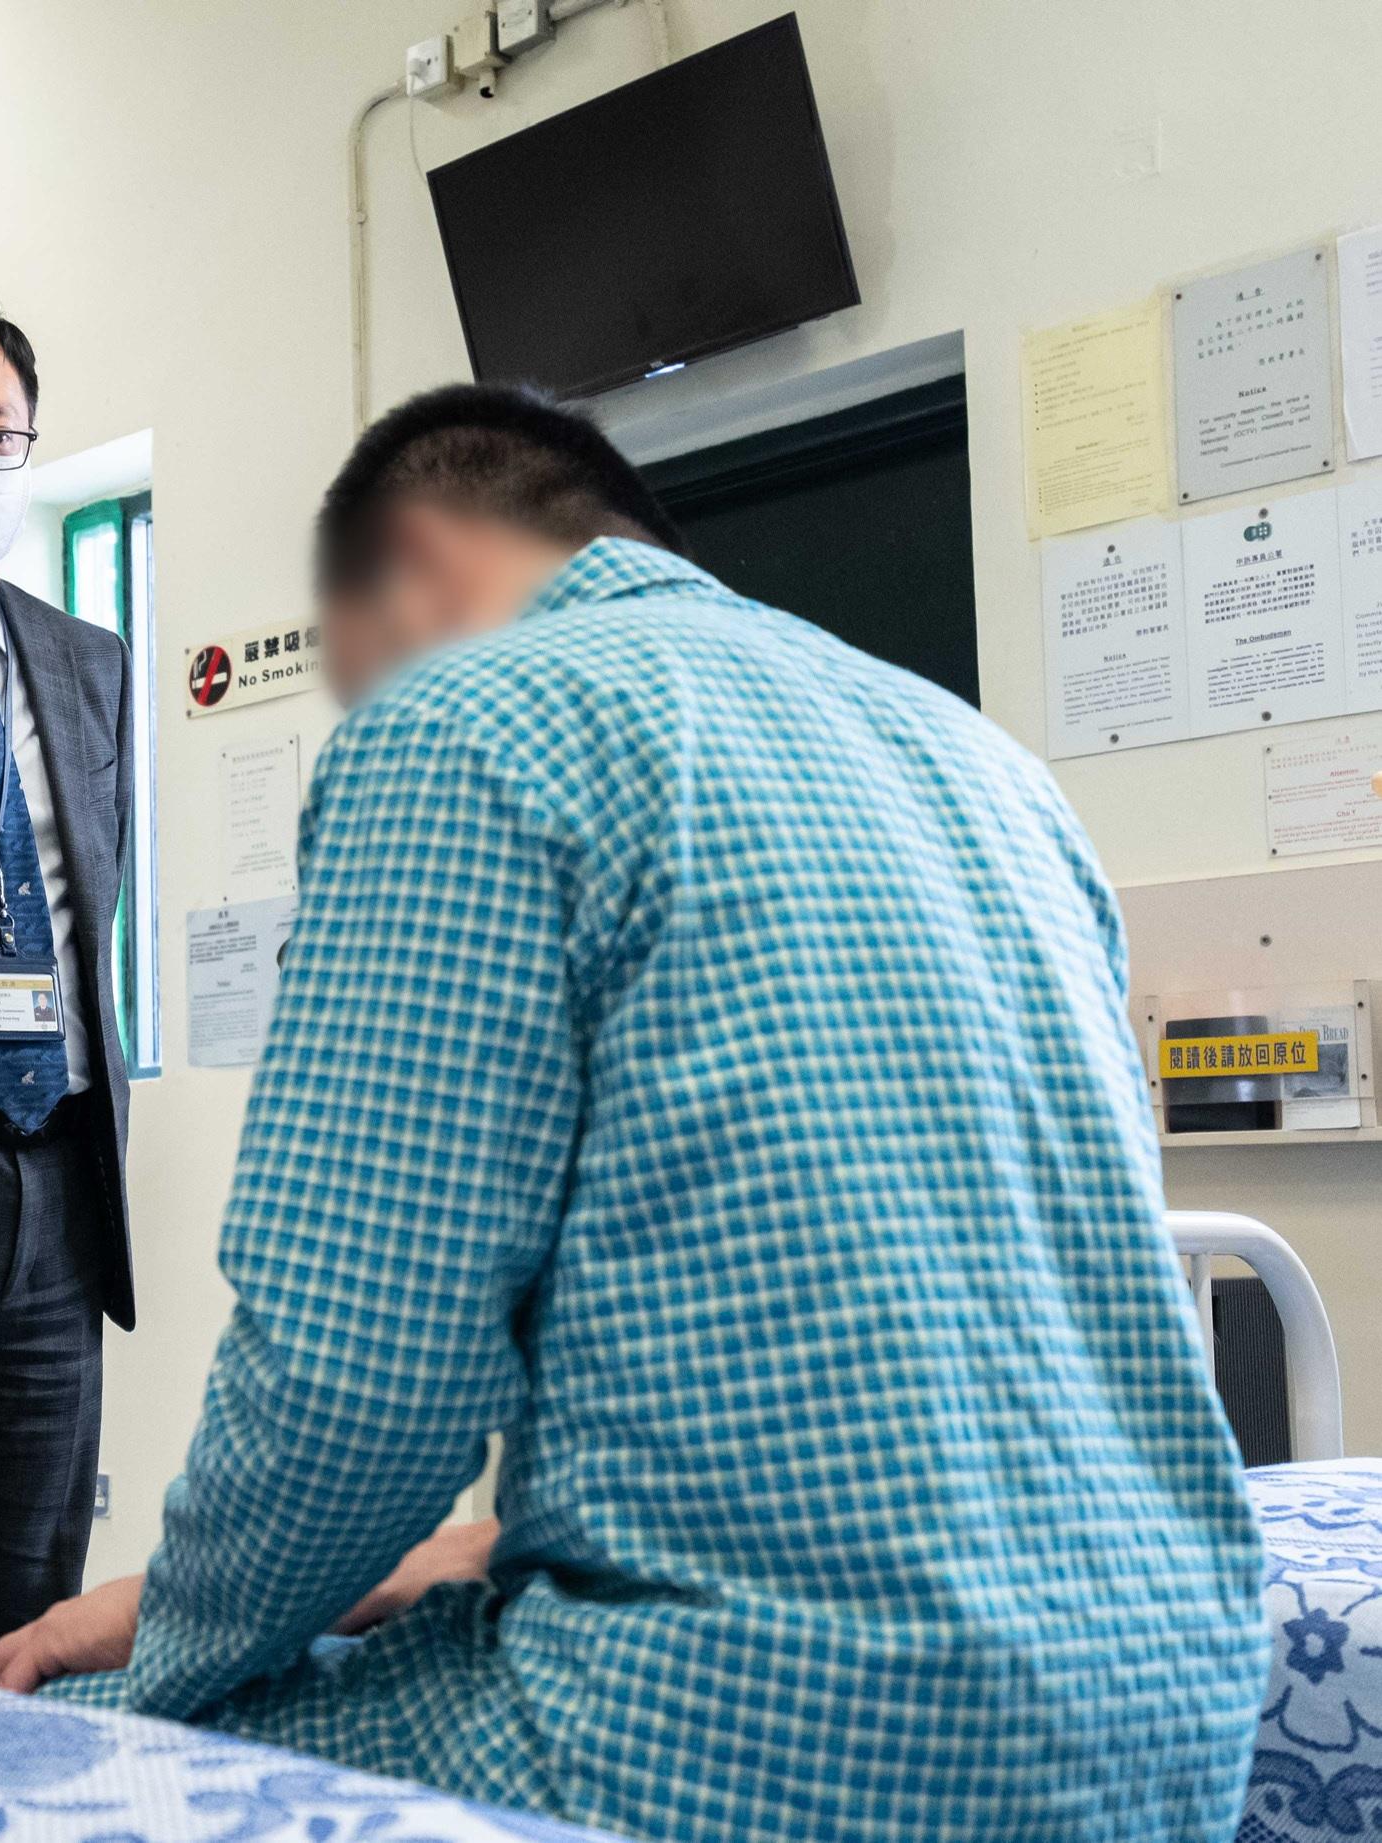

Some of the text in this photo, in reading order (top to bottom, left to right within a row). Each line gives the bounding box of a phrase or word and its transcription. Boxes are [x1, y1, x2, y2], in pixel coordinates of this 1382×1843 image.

[1239, 386, 1266, 398] Notice
[1249, 630, 1291, 643] Ombudsman
[238, 659, 322, 688] No Smokin
[1322, 1024, 1349, 1041] BREAD
[1169, 1041, 1306, 1070] 閱讀後請放回原位
